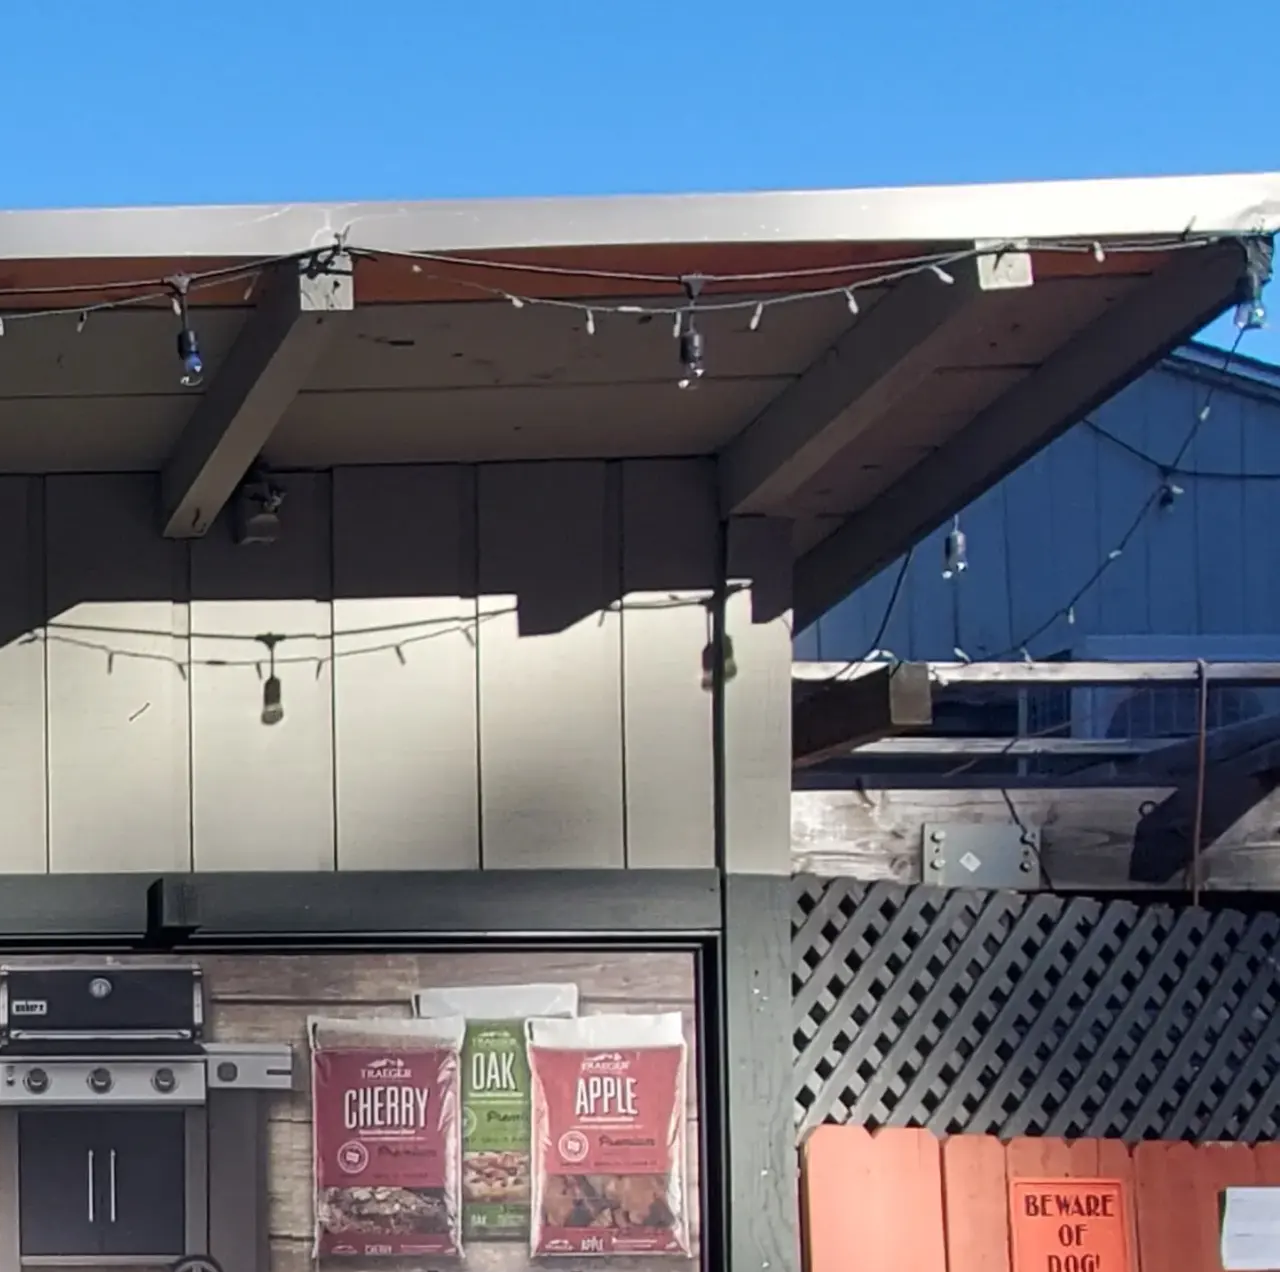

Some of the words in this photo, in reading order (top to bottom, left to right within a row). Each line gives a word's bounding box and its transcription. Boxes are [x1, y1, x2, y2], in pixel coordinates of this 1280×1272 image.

[360, 1068, 413, 1079] TRAEGER
[472, 1052, 518, 1091] OAK
[344, 1086, 428, 1129] CHERRY
[575, 1076, 639, 1116] APPLE
[1024, 1194, 1114, 1217] BEWARE
[1058, 1224, 1089, 1247] OF
